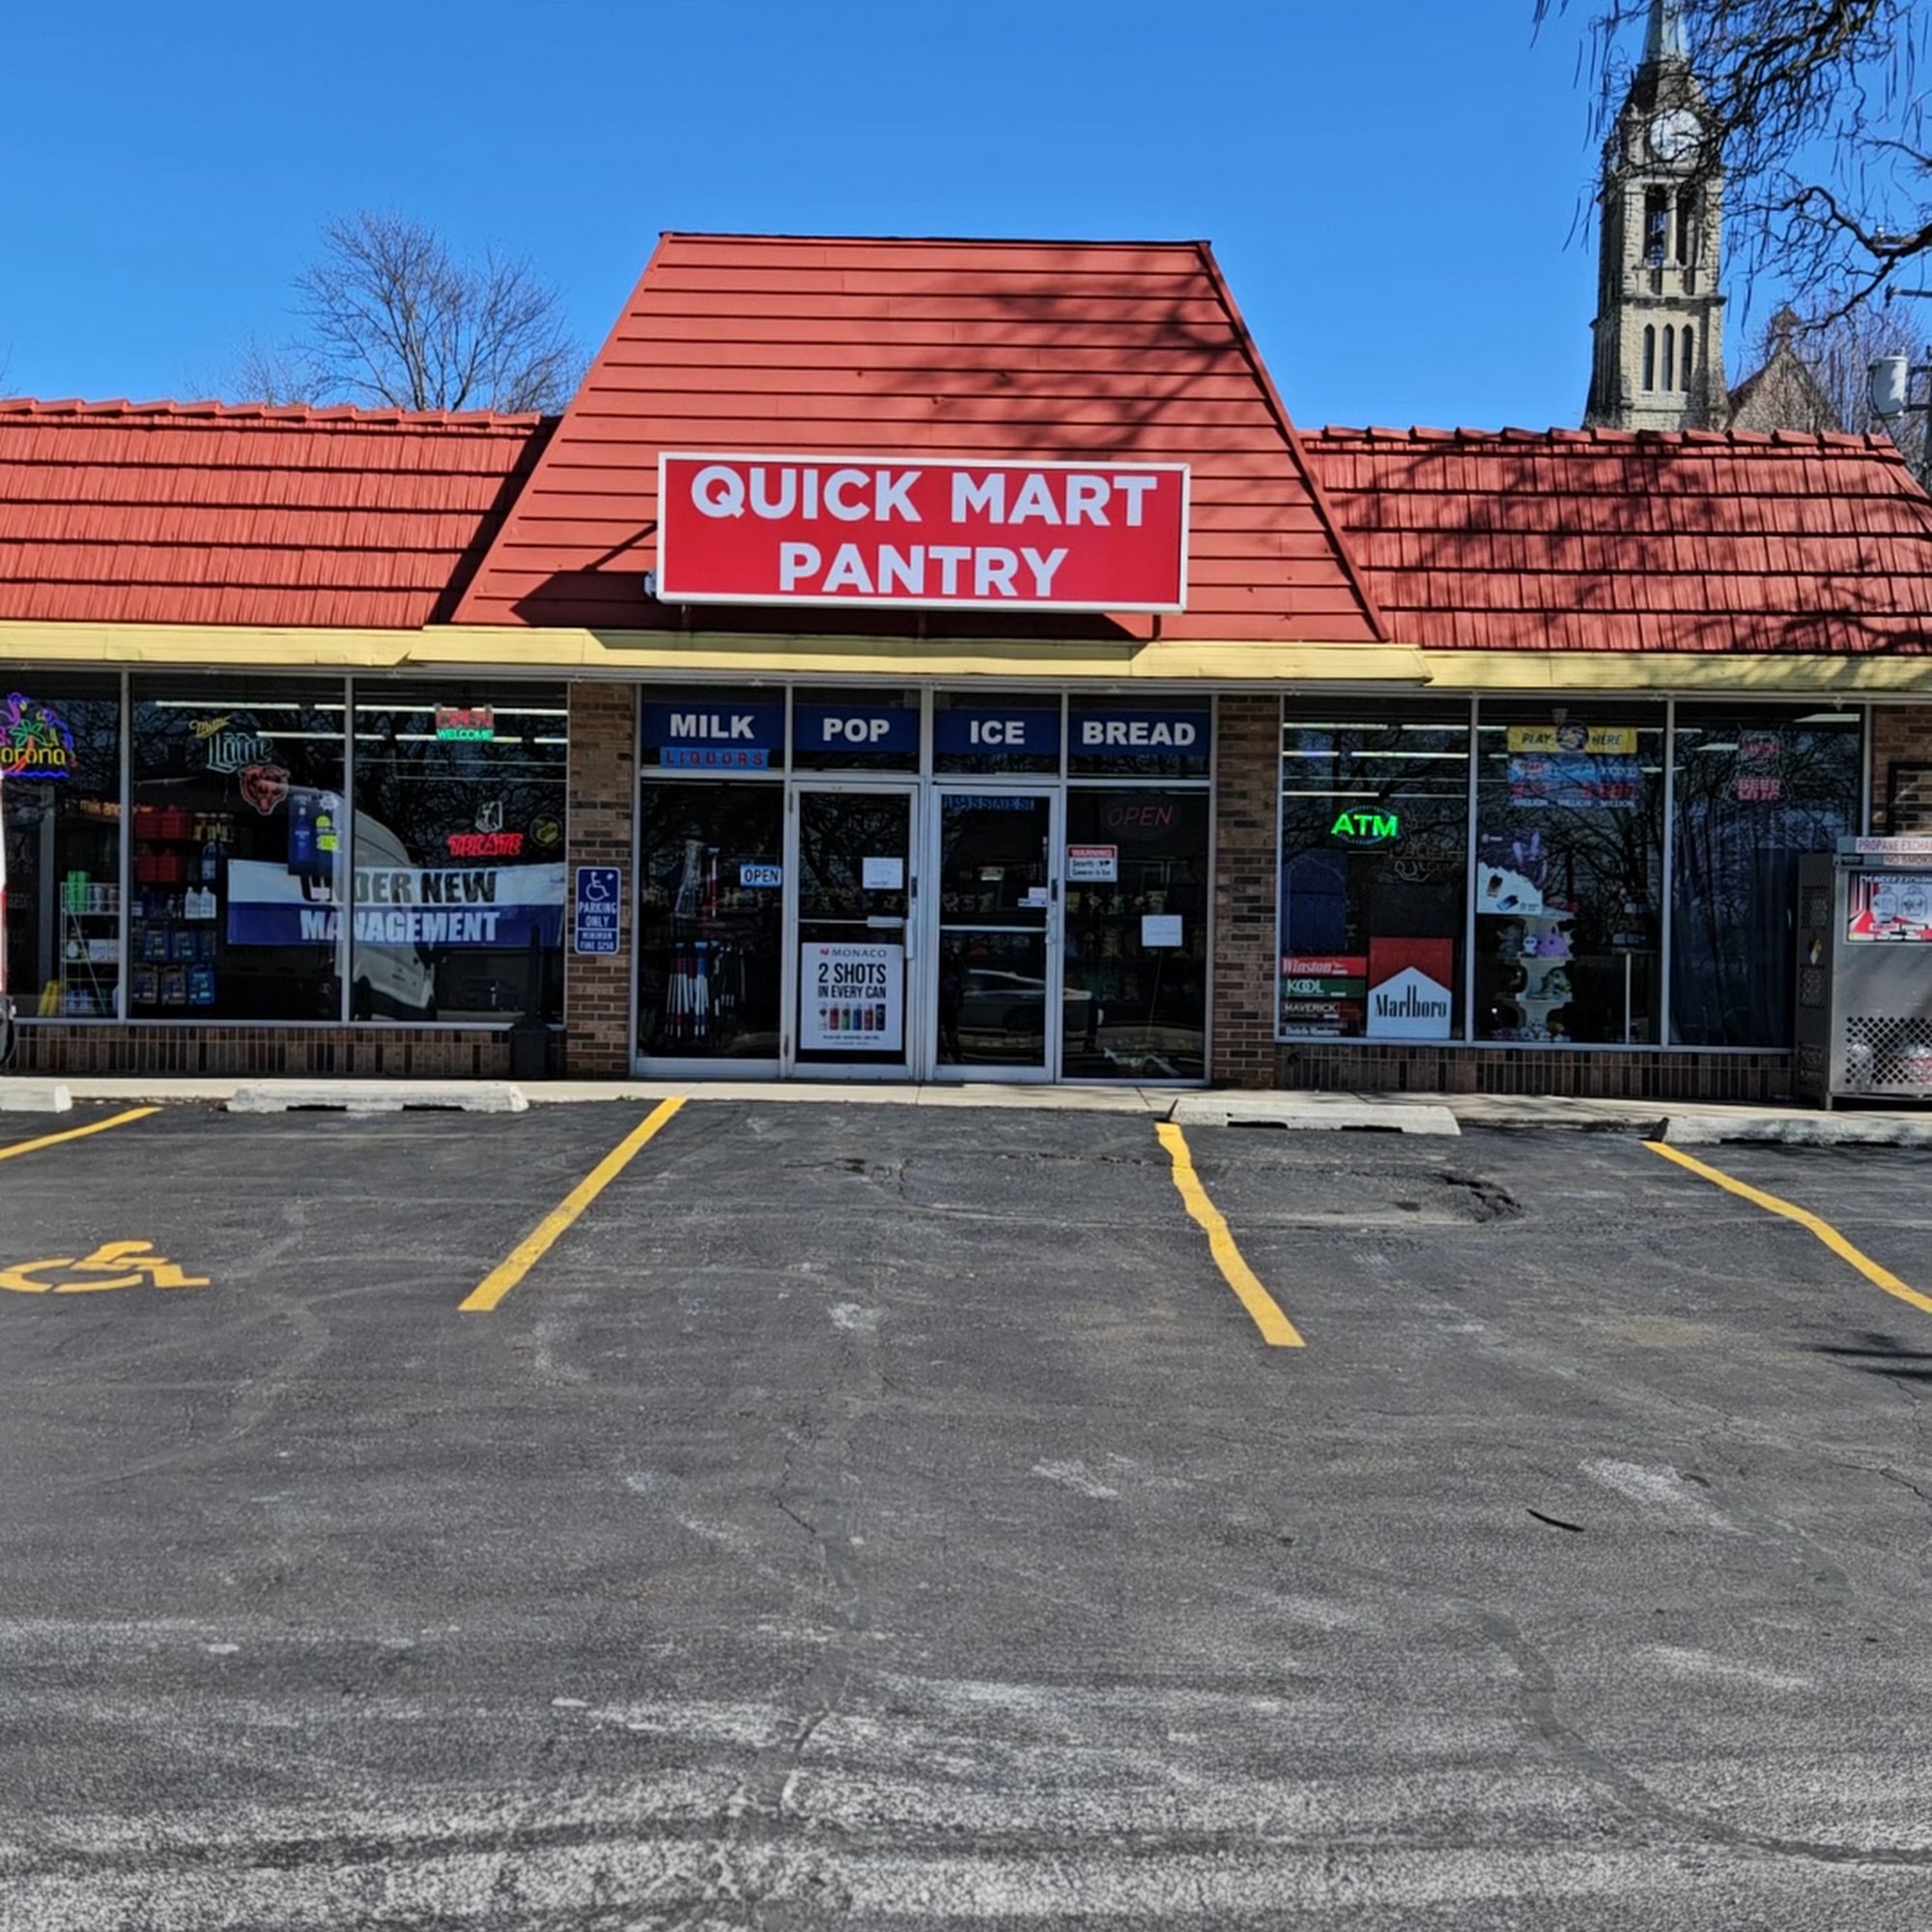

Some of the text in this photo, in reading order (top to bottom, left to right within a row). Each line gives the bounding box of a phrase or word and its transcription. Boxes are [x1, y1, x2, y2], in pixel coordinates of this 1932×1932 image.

[691, 466, 1157, 526] QUICK MART
[779, 542, 1067, 596] PANTRY
[437, 728, 494, 741] WELCOME
[670, 714, 754, 739] MILK
[823, 718, 890, 742] POP
[970, 721, 1025, 744] ICE
[1082, 722, 1196, 746] BREAD
[1521, 733, 1623, 746] PLAY HERE
[666, 750, 763, 766] LIQUORS
[1107, 806, 1173, 826] OPEN
[1331, 813, 1397, 837] ATM
[1071, 848, 1113, 858] WARNING
[1859, 839, 1932, 852] PROPANE EXCHA
[1886, 855, 1898, 864] NO
[744, 868, 779, 883] OPEN
[420, 871, 497, 902] NEW
[580, 902, 616, 914] PARKING
[299, 910, 499, 943] MANAGEMENT
[585, 915, 610, 926] ONLY
[832, 949, 887, 958] MONACO
[818, 962, 887, 984] 2 SHOTS
[1283, 957, 1332, 975] Winston
[818, 985, 887, 999] IN EVERY CAN
[1287, 979, 1324, 993] KOOL
[1284, 1003, 1337, 1013] MAVERICK
[1376, 984, 1447, 1018] Marlboro
